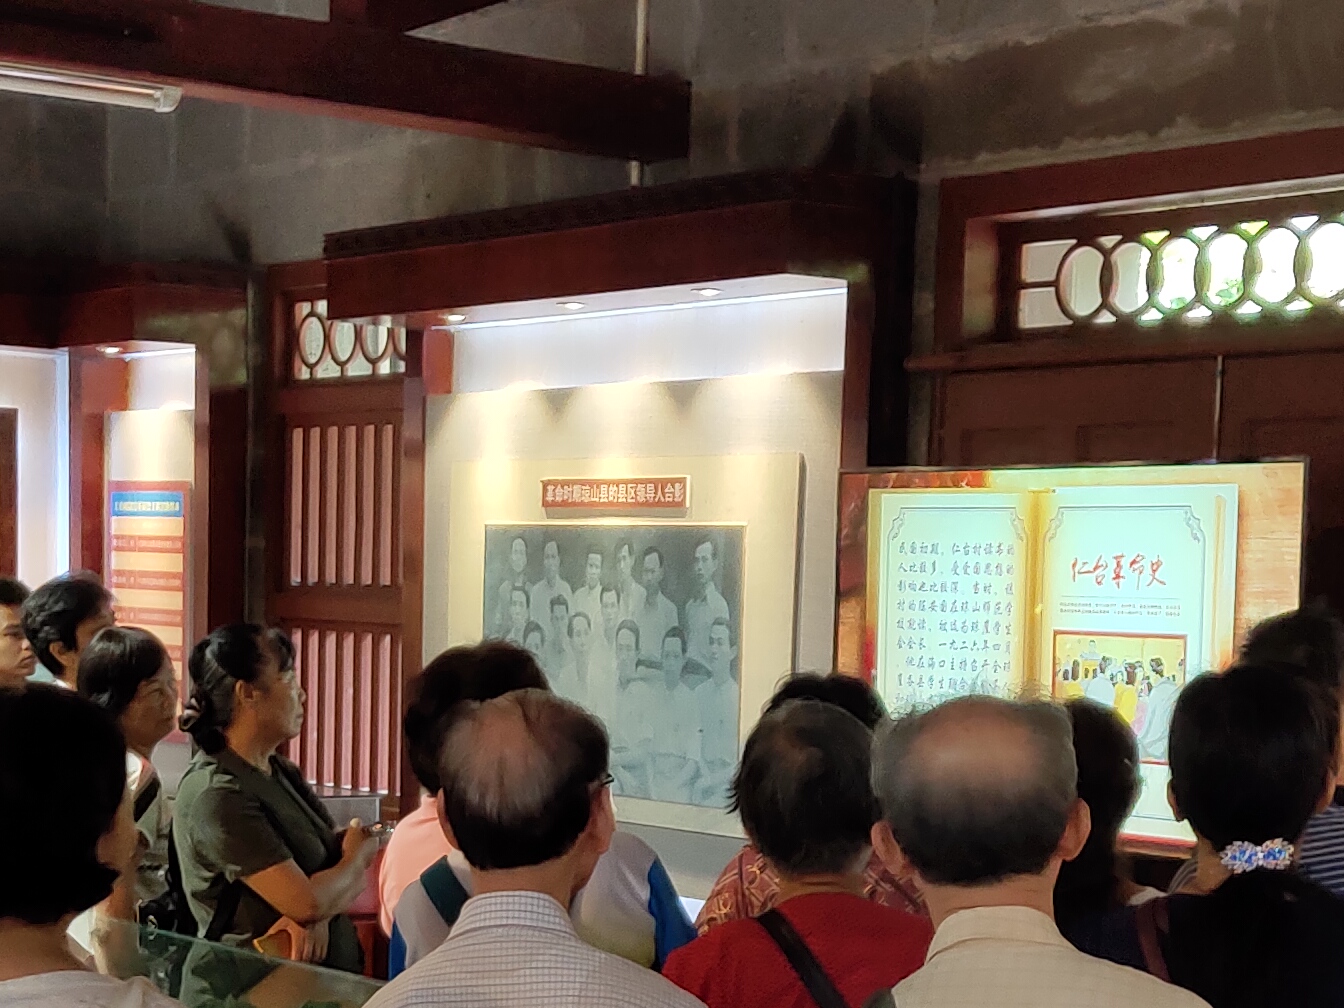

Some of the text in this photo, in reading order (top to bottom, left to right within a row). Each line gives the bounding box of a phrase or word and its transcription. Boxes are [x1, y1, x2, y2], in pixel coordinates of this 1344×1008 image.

[1071, 553, 1166, 590] 仁台革命史
